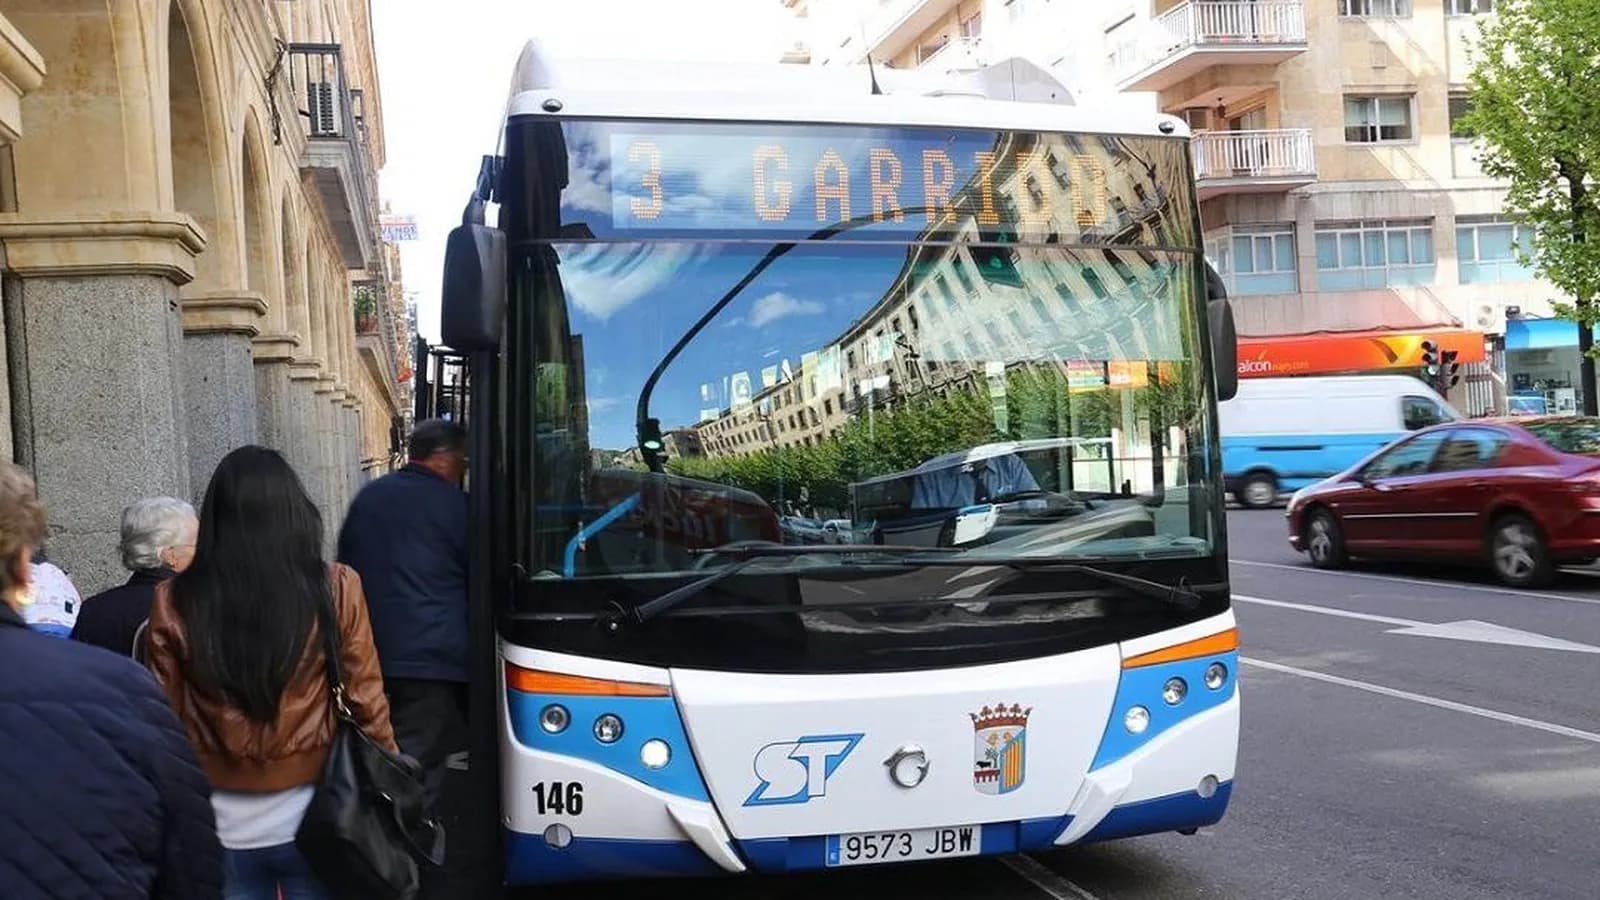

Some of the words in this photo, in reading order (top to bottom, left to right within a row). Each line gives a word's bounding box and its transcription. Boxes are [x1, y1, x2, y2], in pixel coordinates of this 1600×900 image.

[627, 141, 664, 220] 3
[752, 143, 1104, 226] GARRIDO
[742, 732, 865, 807] ST
[531, 781, 584, 816] 146
[846, 833, 913, 861] 9573
[925, 827, 973, 854] JBW
